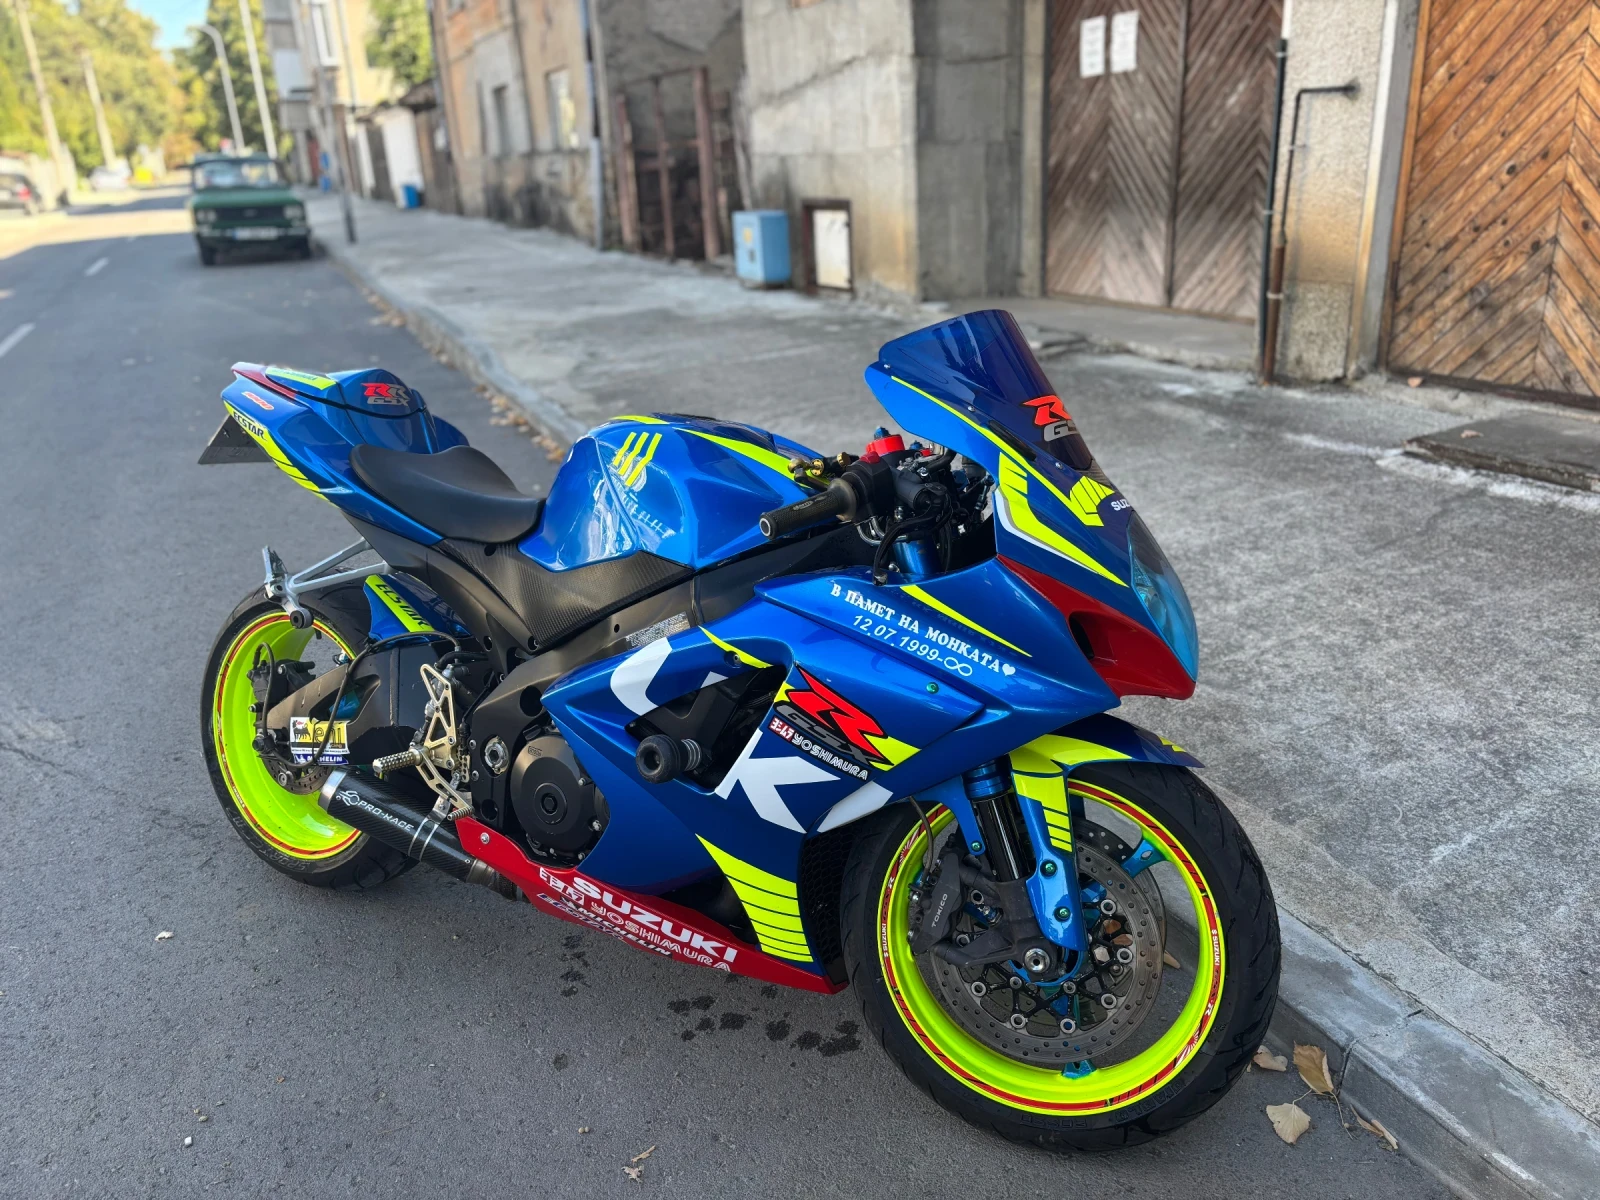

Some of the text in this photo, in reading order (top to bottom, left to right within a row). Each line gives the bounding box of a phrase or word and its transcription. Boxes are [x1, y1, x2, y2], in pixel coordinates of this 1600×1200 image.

[232, 410, 268, 441] ECSTAR
[375, 583, 430, 630] ECSTAR
[830, 582, 1001, 673] В ПАМЕТ НА МОНКАТА
[776, 704, 885, 766] GSX
[791, 732, 869, 781] YOSHIMURA
[573, 876, 738, 963] SUZUKI
[577, 905, 673, 957] MICHELIN
[931, 893, 948, 928] TOKICO
[590, 901, 731, 972] YOSHIMURA
[1212, 935, 1220, 966] SUZUKI
